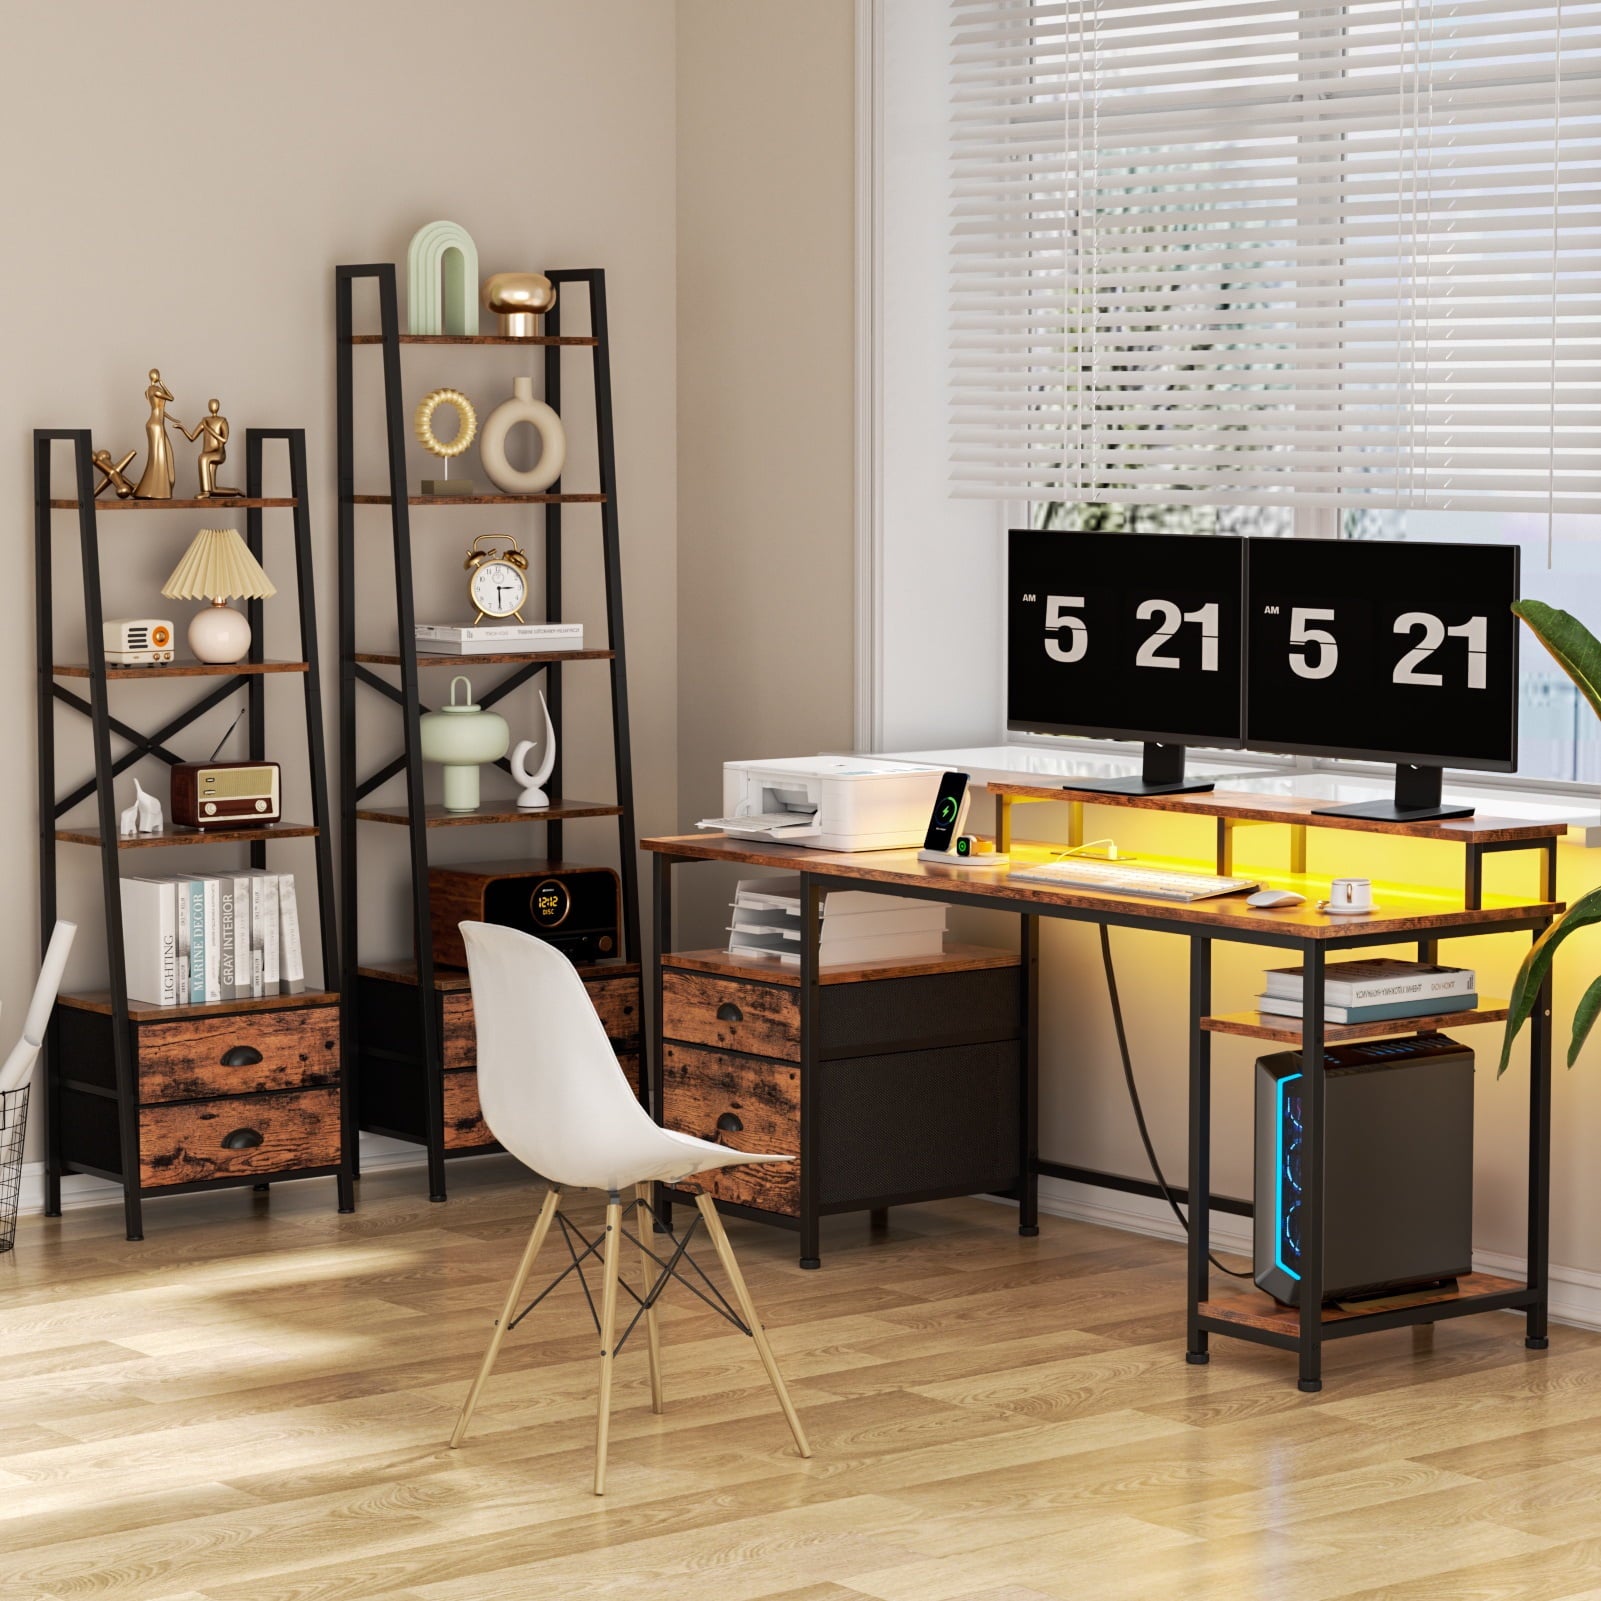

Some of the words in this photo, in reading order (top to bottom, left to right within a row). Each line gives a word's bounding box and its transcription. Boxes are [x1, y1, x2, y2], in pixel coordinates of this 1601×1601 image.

[1022, 594, 1036, 602] AM
[1045, 596, 1087, 662] 5
[1136, 600, 1218, 671] 21
[1264, 605, 1280, 615] AM
[1289, 608, 1338, 679] 5
[1393, 612, 1487, 689] 21
[193, 894, 204, 937] DECOR
[223, 894, 233, 950] INTERIOR
[538, 895, 559, 908] 12:12
[164, 935, 174, 1000] LIGHTING
[193, 940, 204, 991] MARINE
[223, 953, 233, 985] GRAY
